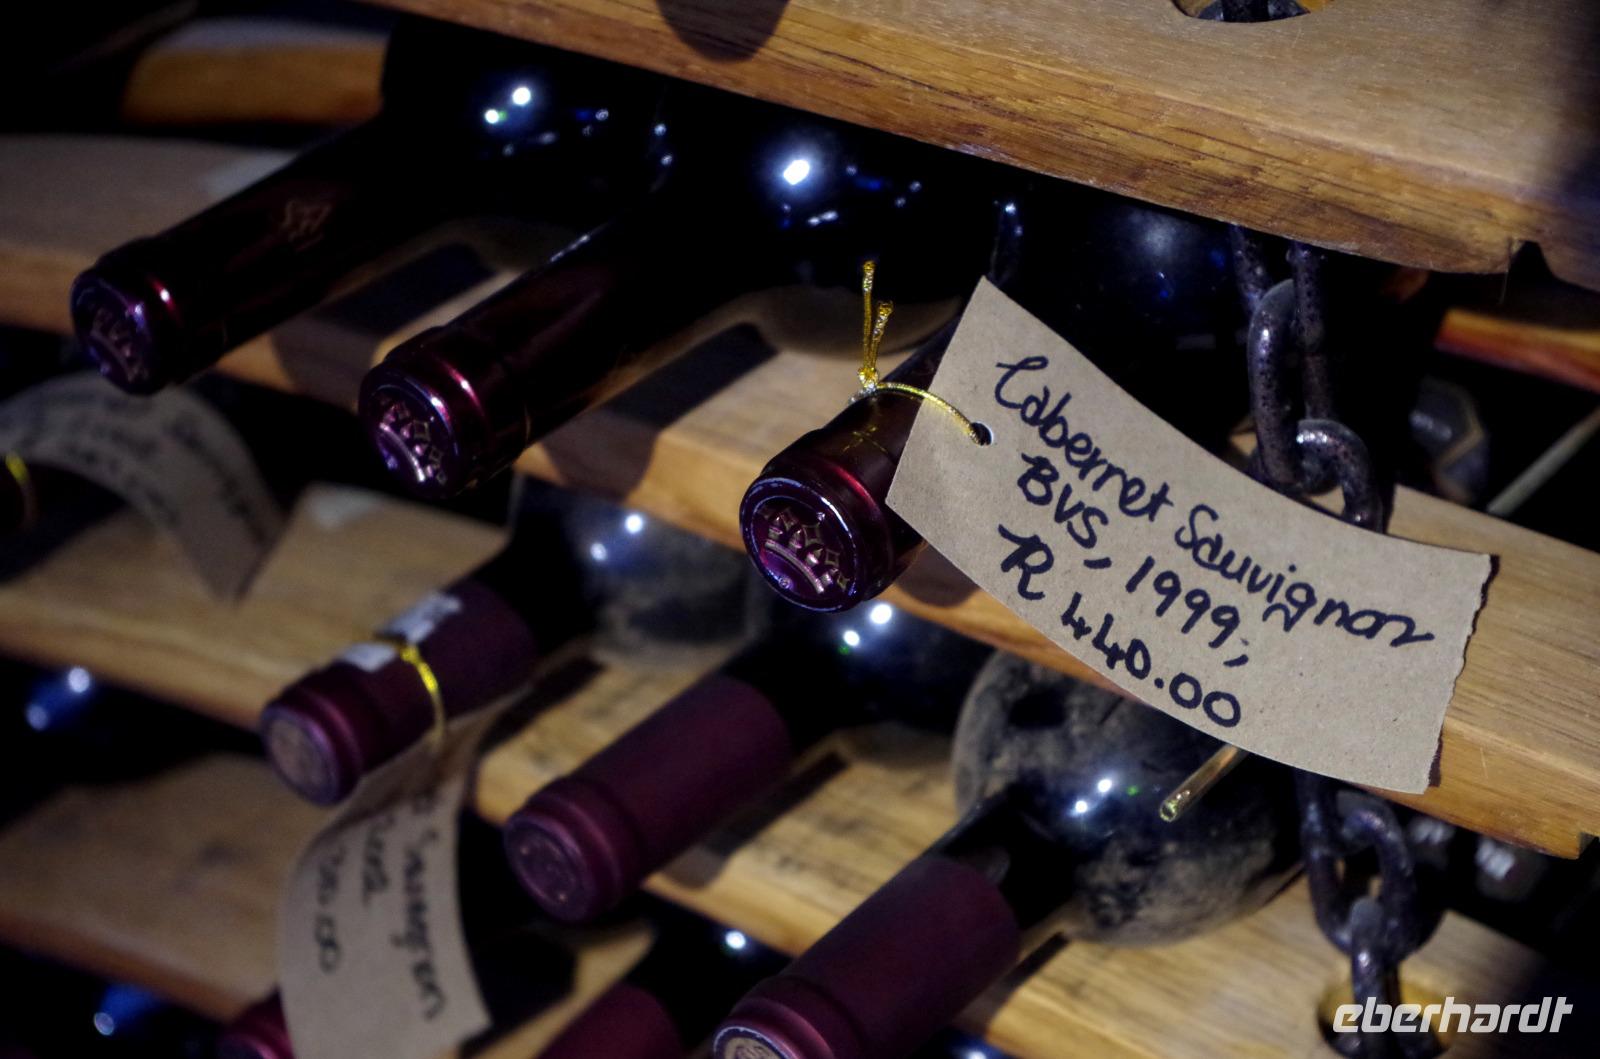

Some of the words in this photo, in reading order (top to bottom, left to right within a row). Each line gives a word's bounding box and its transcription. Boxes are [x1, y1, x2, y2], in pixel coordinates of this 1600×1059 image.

[998, 523, 1055, 601] R
[1060, 591, 1242, 728] 440.00
[1174, 503, 1436, 648] Sauvignon
